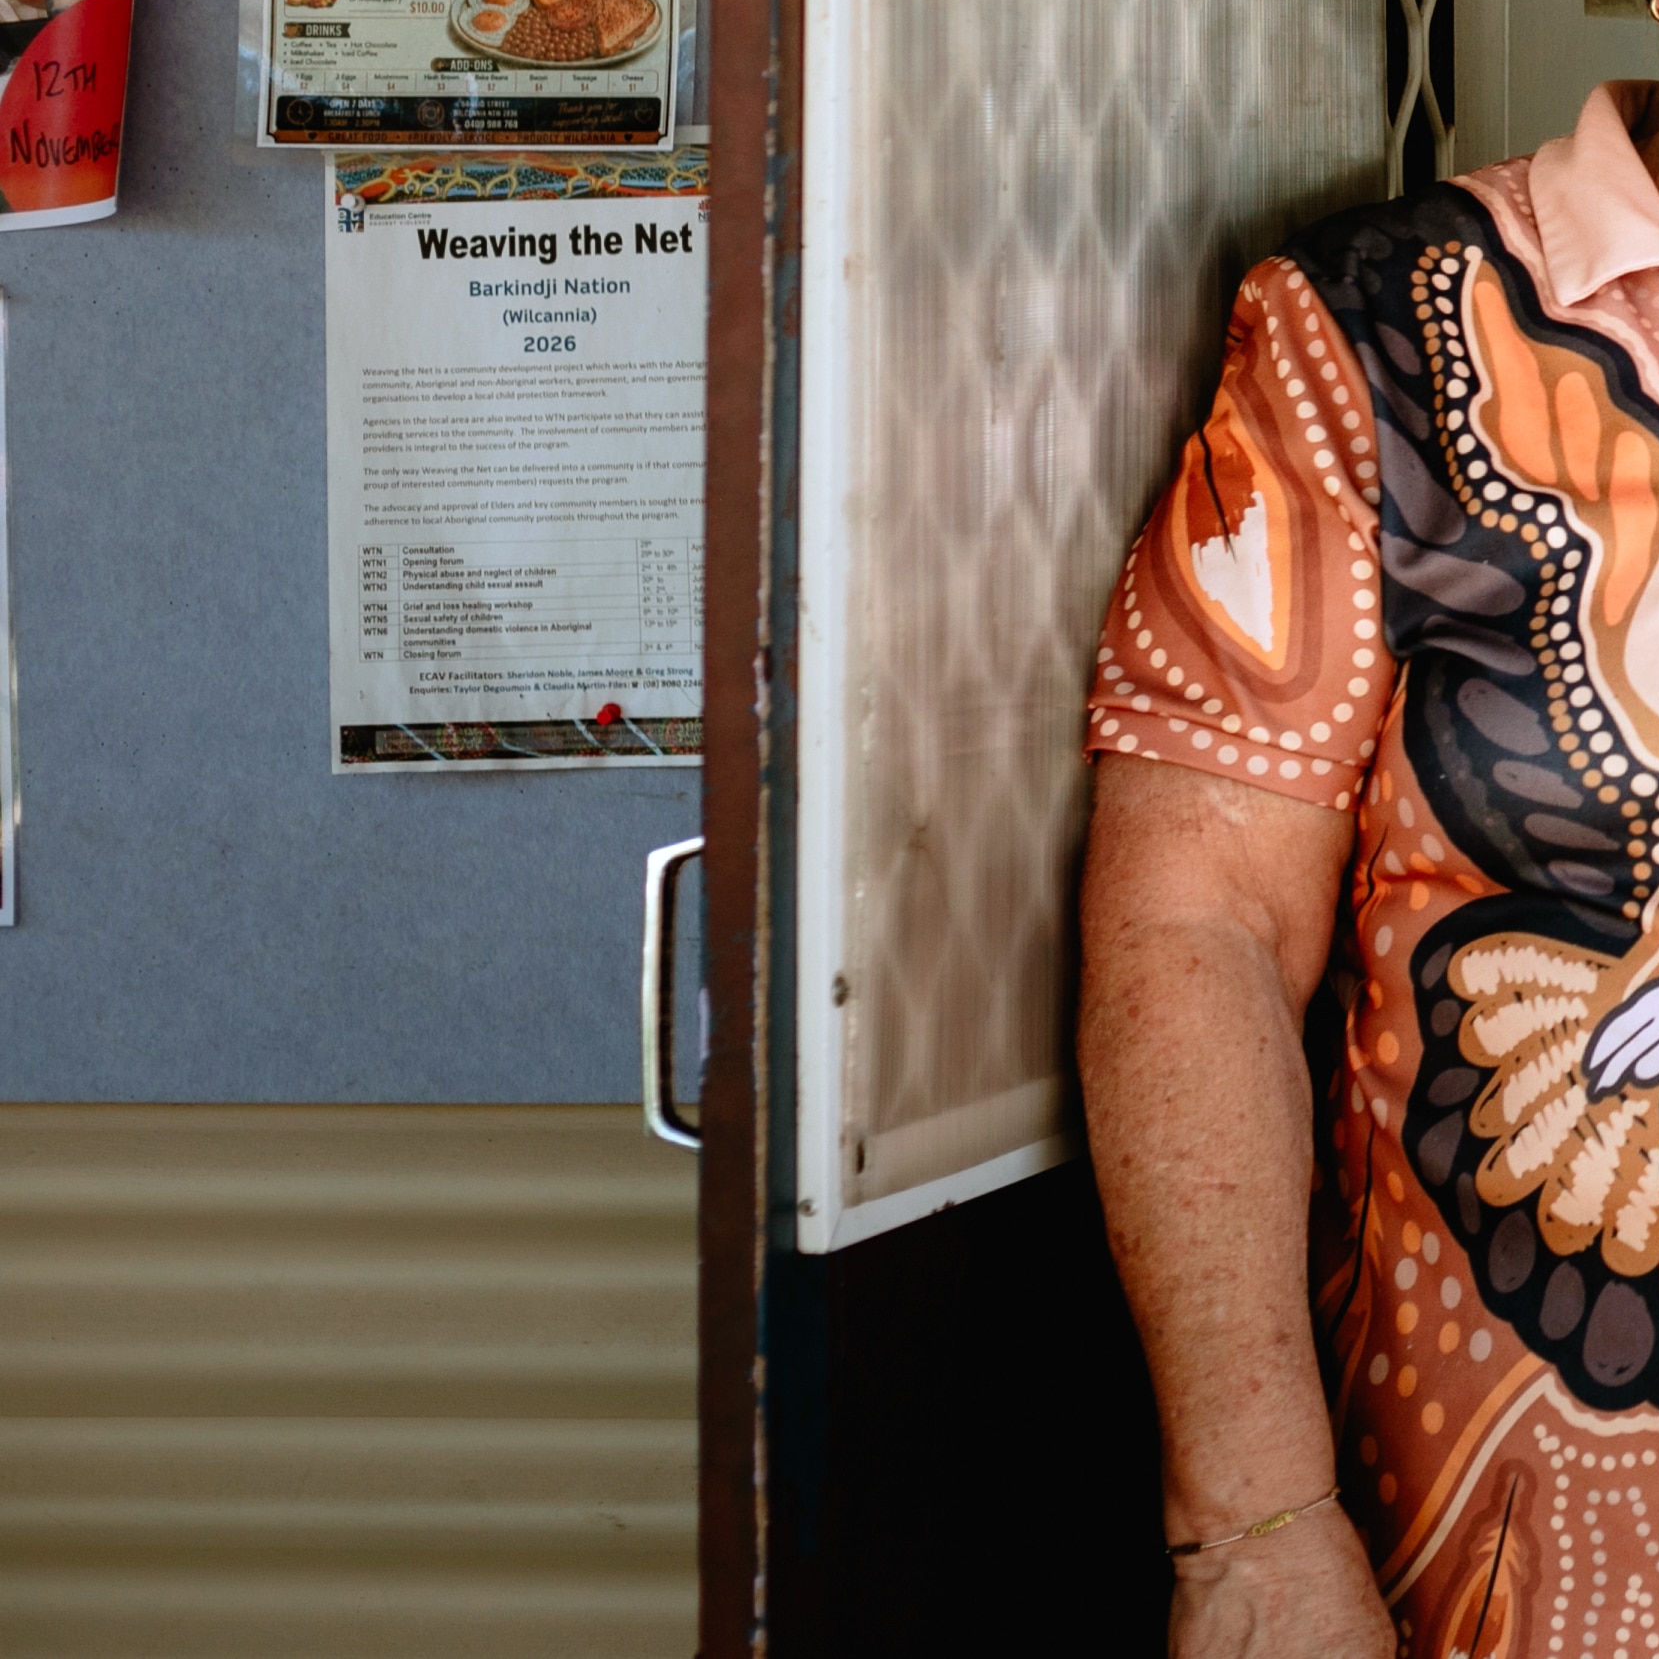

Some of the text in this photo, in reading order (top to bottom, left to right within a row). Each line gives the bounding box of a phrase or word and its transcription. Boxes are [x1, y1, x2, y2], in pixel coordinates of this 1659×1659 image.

[409, 1, 445, 14] $10.00
[305, 25, 342, 37] DRINKS
[450, 59, 494, 71] ADD-ONS
[33, 60, 97, 101] 12TH
[10, 119, 120, 168] NOVEMBER
[417, 222, 693, 264] Weaving the Net
[469, 277, 631, 299] Barkindji Nation
[502, 307, 597, 326] (Wilcannia)
[524, 335, 577, 353] 2026
[402, 567, 556, 580] Physical abuse and neglect of children
